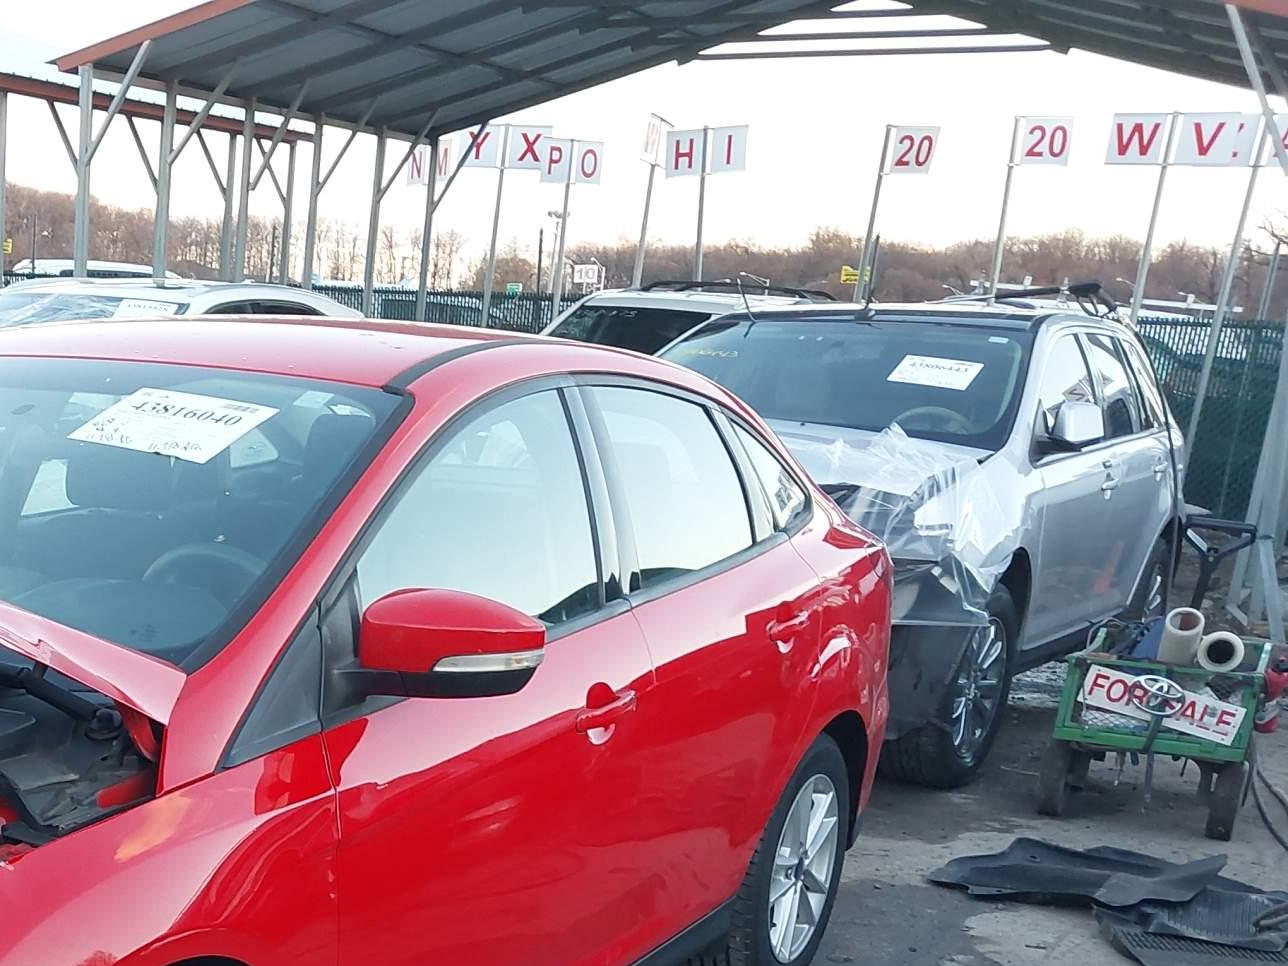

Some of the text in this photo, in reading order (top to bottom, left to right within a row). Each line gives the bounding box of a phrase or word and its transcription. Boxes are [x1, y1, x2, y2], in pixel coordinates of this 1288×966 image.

[468, 131, 490, 160] Y
[517, 132, 543, 162] X
[674, 138, 694, 170] H
[894, 135, 934, 167] 20
[1025, 125, 1069, 158] 20
[1115, 122, 1161, 157] W
[1194, 122, 1226, 156] V
[547, 146, 563, 175] P
[1088, 673, 1237, 736] FOR ALE
